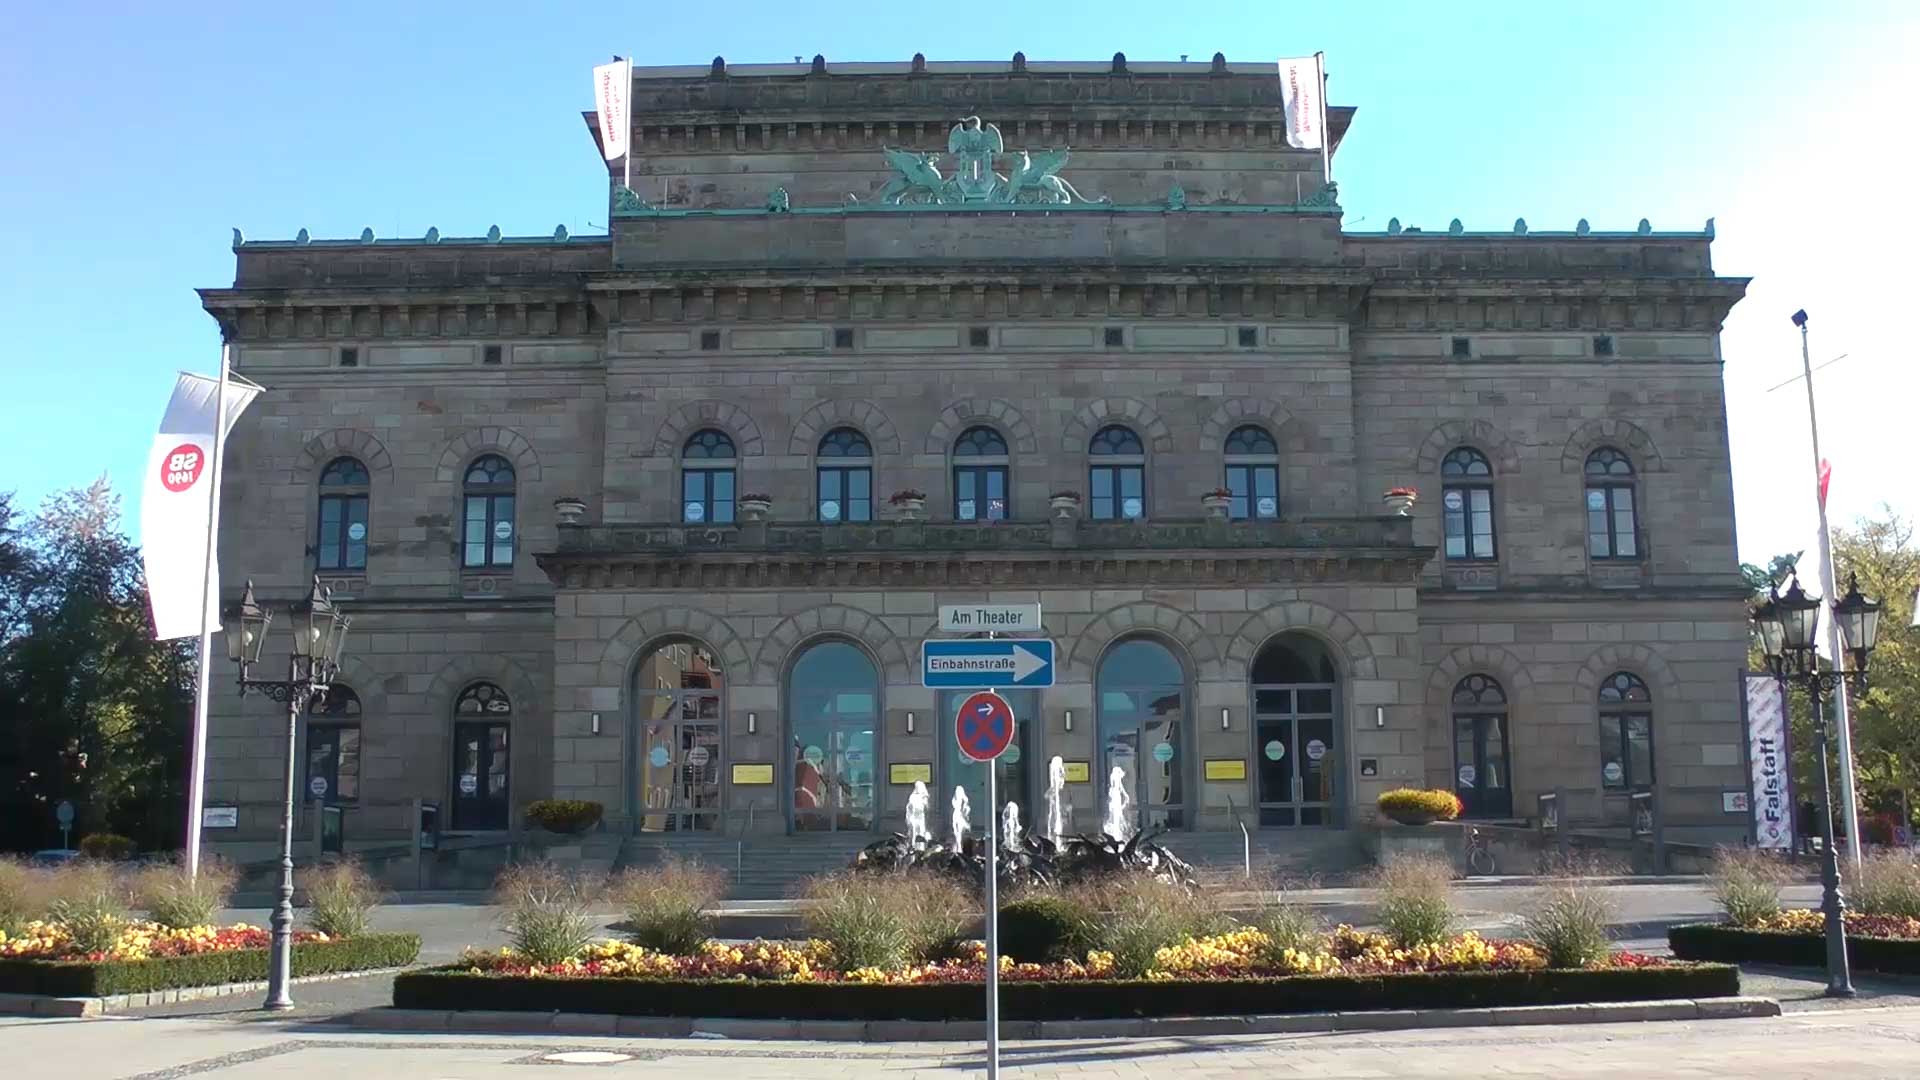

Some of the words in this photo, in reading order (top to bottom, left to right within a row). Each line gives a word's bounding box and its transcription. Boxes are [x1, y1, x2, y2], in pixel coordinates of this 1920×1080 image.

[952, 609, 971, 625] Am
[975, 608, 1023, 625] Theater
[930, 657, 1016, 671] Einbahnstraße
[1759, 737, 1780, 823] Falstaff
